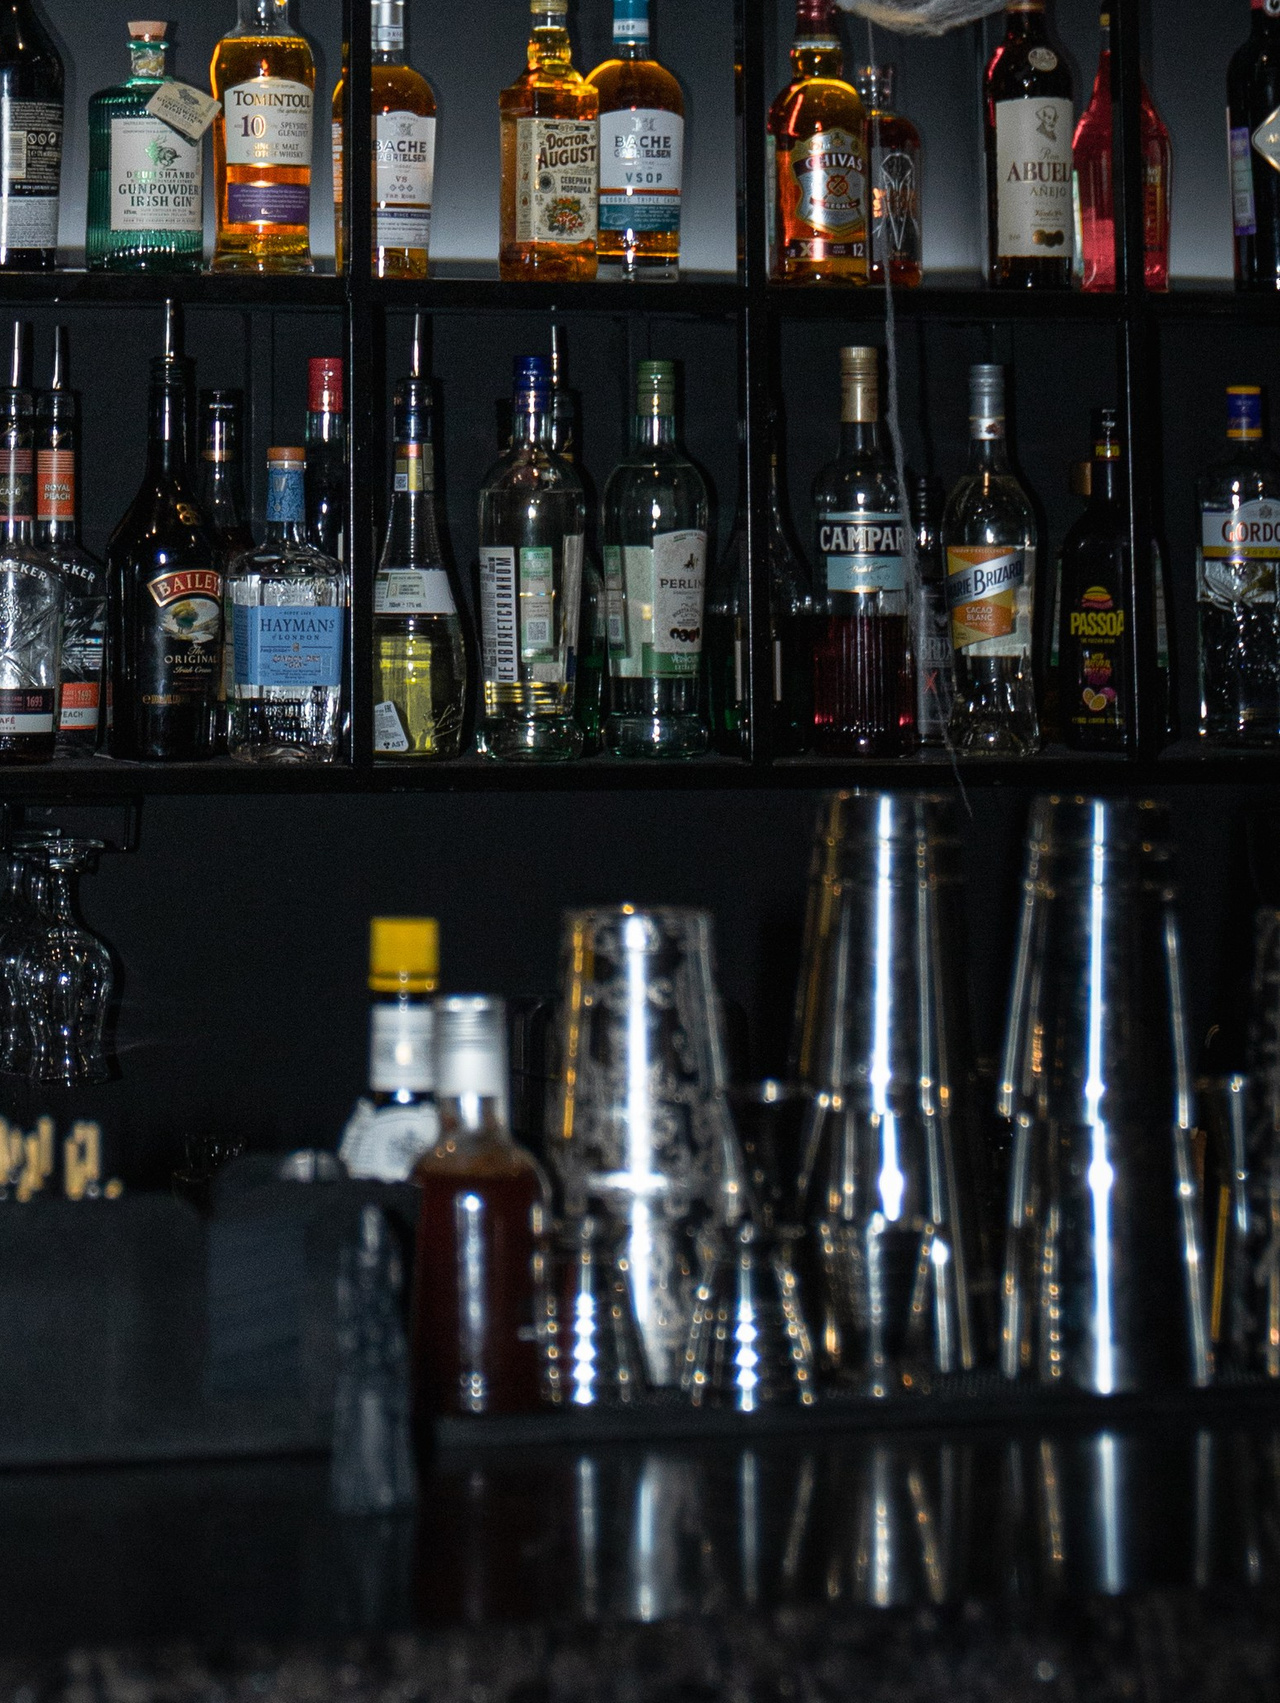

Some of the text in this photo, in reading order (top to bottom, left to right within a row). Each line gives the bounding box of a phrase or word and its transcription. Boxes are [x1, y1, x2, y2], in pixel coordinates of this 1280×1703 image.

[233, 90, 312, 108] TOMINTOUL
[241, 114, 266, 138] 10
[280, 122, 308, 130] SPEYSIDE
[282, 143, 300, 151] MALT
[371, 140, 427, 154] BACHE
[545, 133, 589, 150] DOCTOR
[614, 135, 671, 149] BACHE
[279, 150, 304, 159] WHISKY
[537, 145, 597, 171] AUGUST
[614, 148, 671, 159] GRIELSEN
[805, 153, 863, 171] CHIVAS
[560, 176, 592, 184] СЕВЕРНАЯ
[625, 172, 663, 183] VSOP
[118, 183, 200, 196] GUNPOWDER
[560, 185, 591, 194] МОРОШКА
[1030, 184, 1067, 198] AÑEJO
[131, 196, 193, 207] IRISH GIN
[852, 242, 864, 256] 12
[44, 483, 71, 492] ROYAL
[43, 492, 71, 501] PEACH
[820, 526, 905, 551] CAMPAR
[660, 578, 702, 589] PERLIN
[950, 560, 1021, 598] ARIE BRIZARD
[965, 606, 993, 614] CACAO
[966, 613, 993, 621] BLANC
[164, 655, 217, 664] ORIGINAL
[26, 696, 43, 708] 1693
[391, 739, 405, 748] AST
